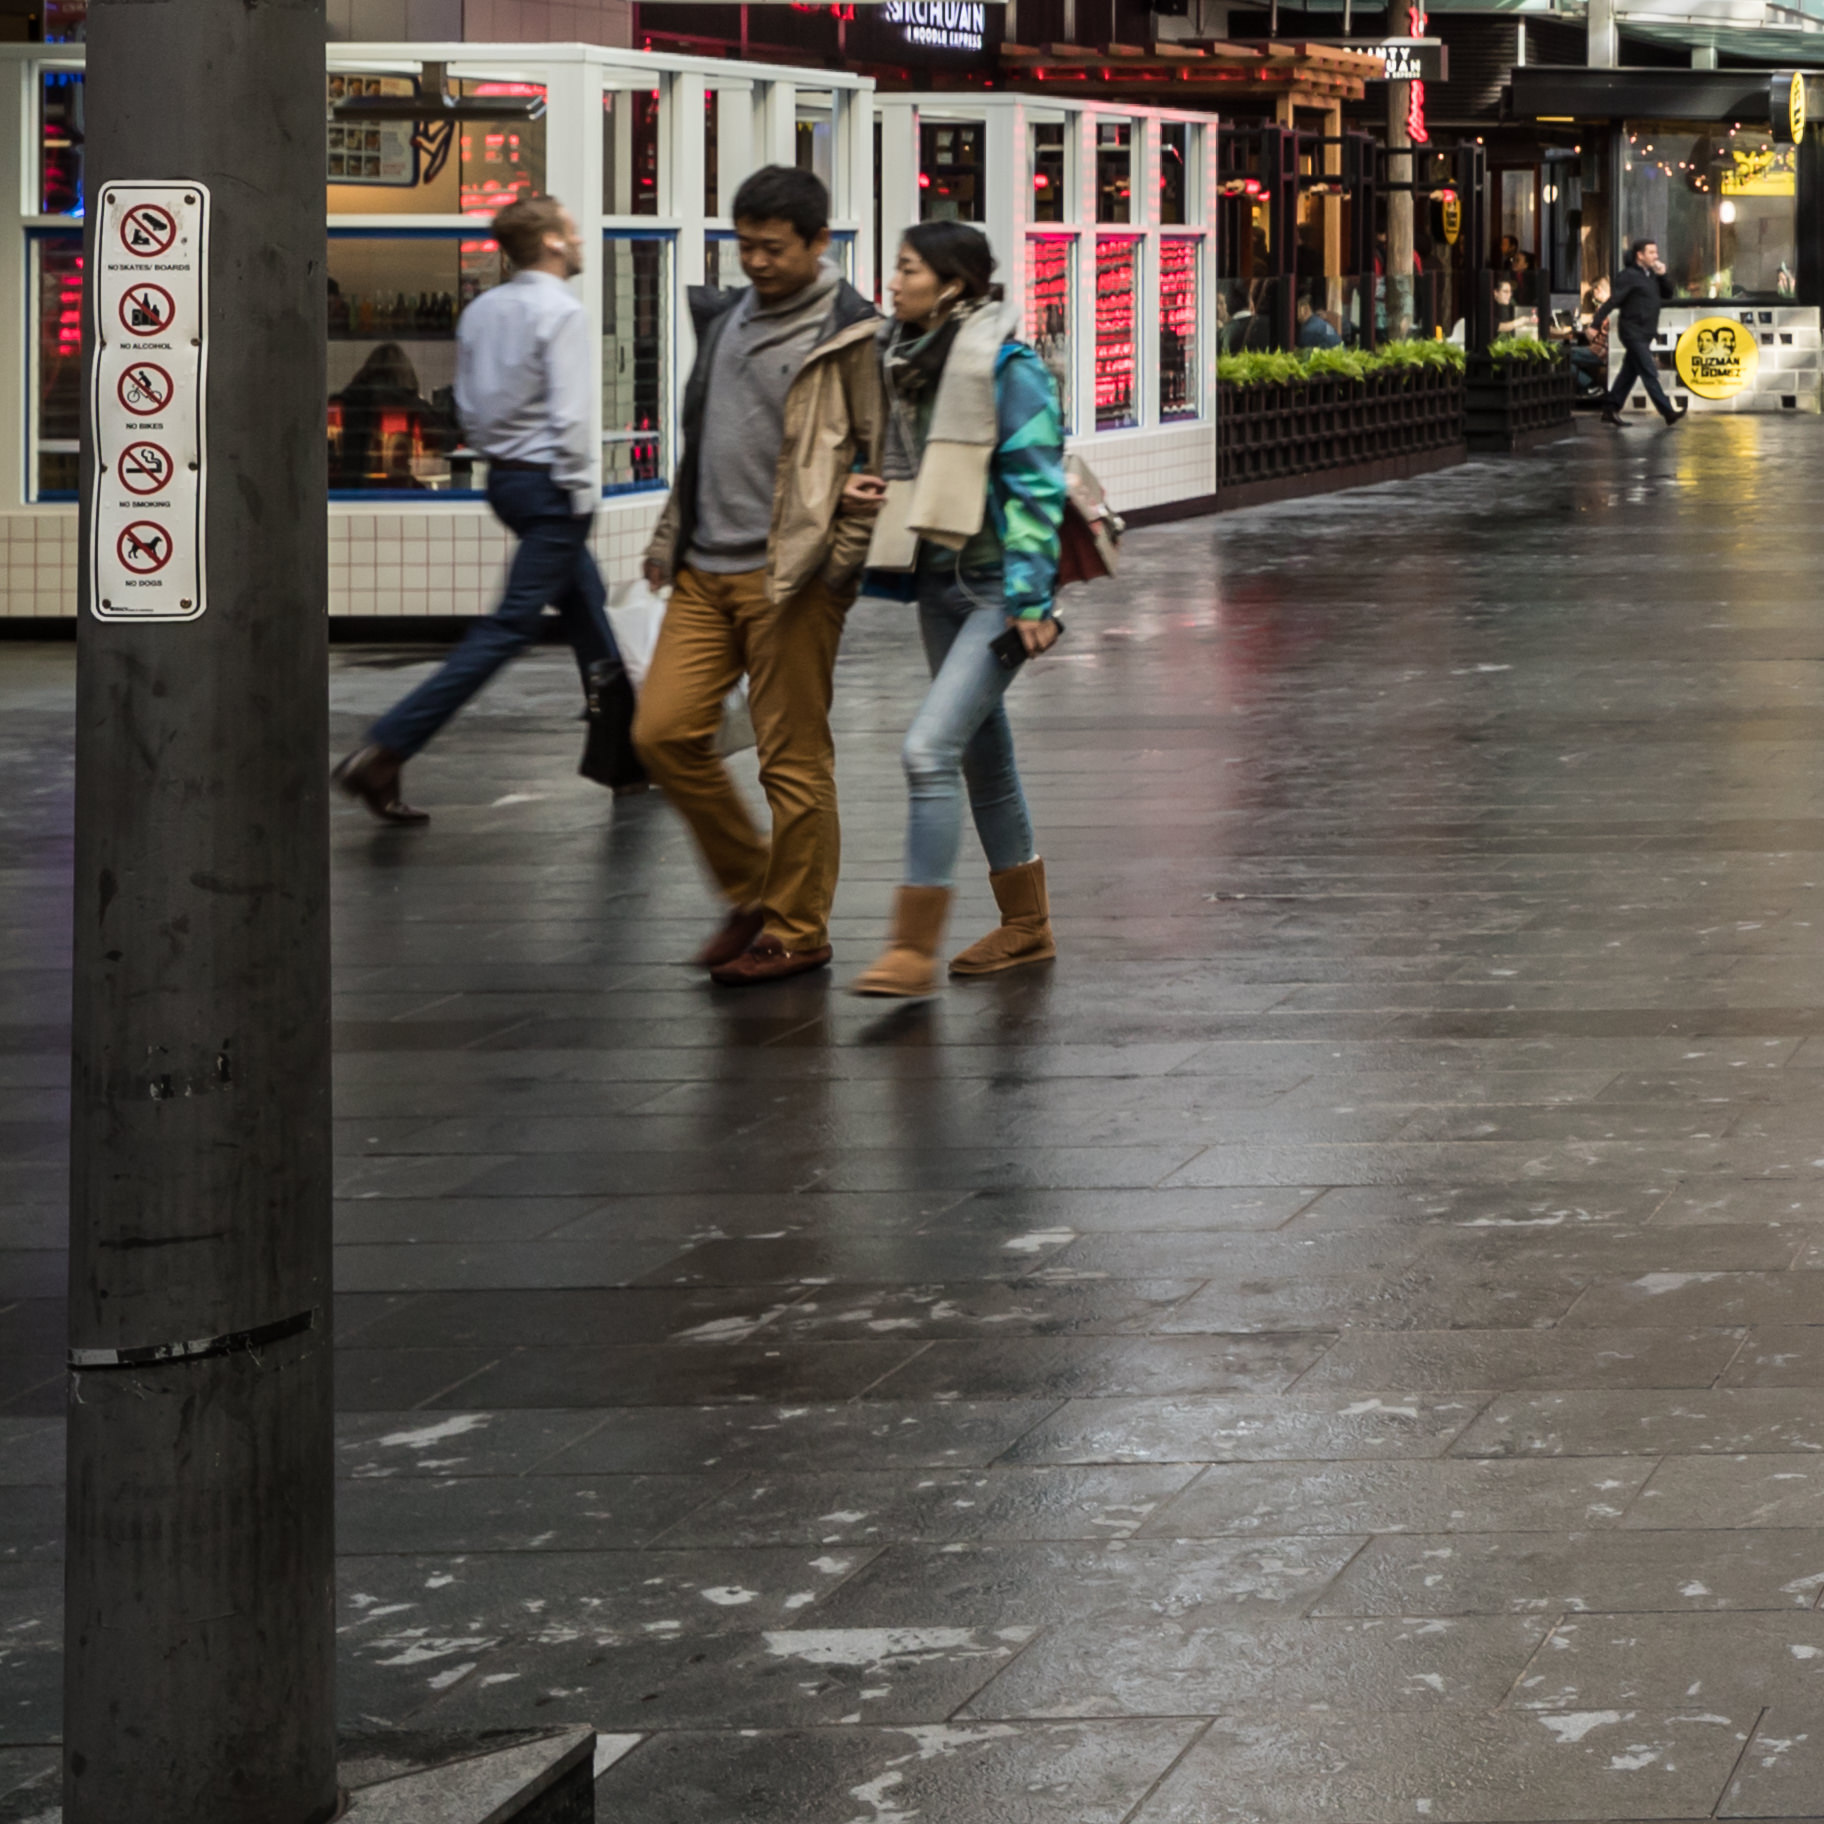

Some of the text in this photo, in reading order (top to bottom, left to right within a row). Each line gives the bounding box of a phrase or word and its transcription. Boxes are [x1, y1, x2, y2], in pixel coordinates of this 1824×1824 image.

[913, 26, 982, 50] NOODLE EXPRESS
[120, 342, 131, 350] NO
[1691, 356, 1740, 366] GUZMAN
[1691, 368, 1741, 377] Y GOMEZ
[126, 422, 164, 430] NO BIKES
[119, 500, 171, 508] NO SMOKING
[125, 579, 163, 587] NO DOGS
